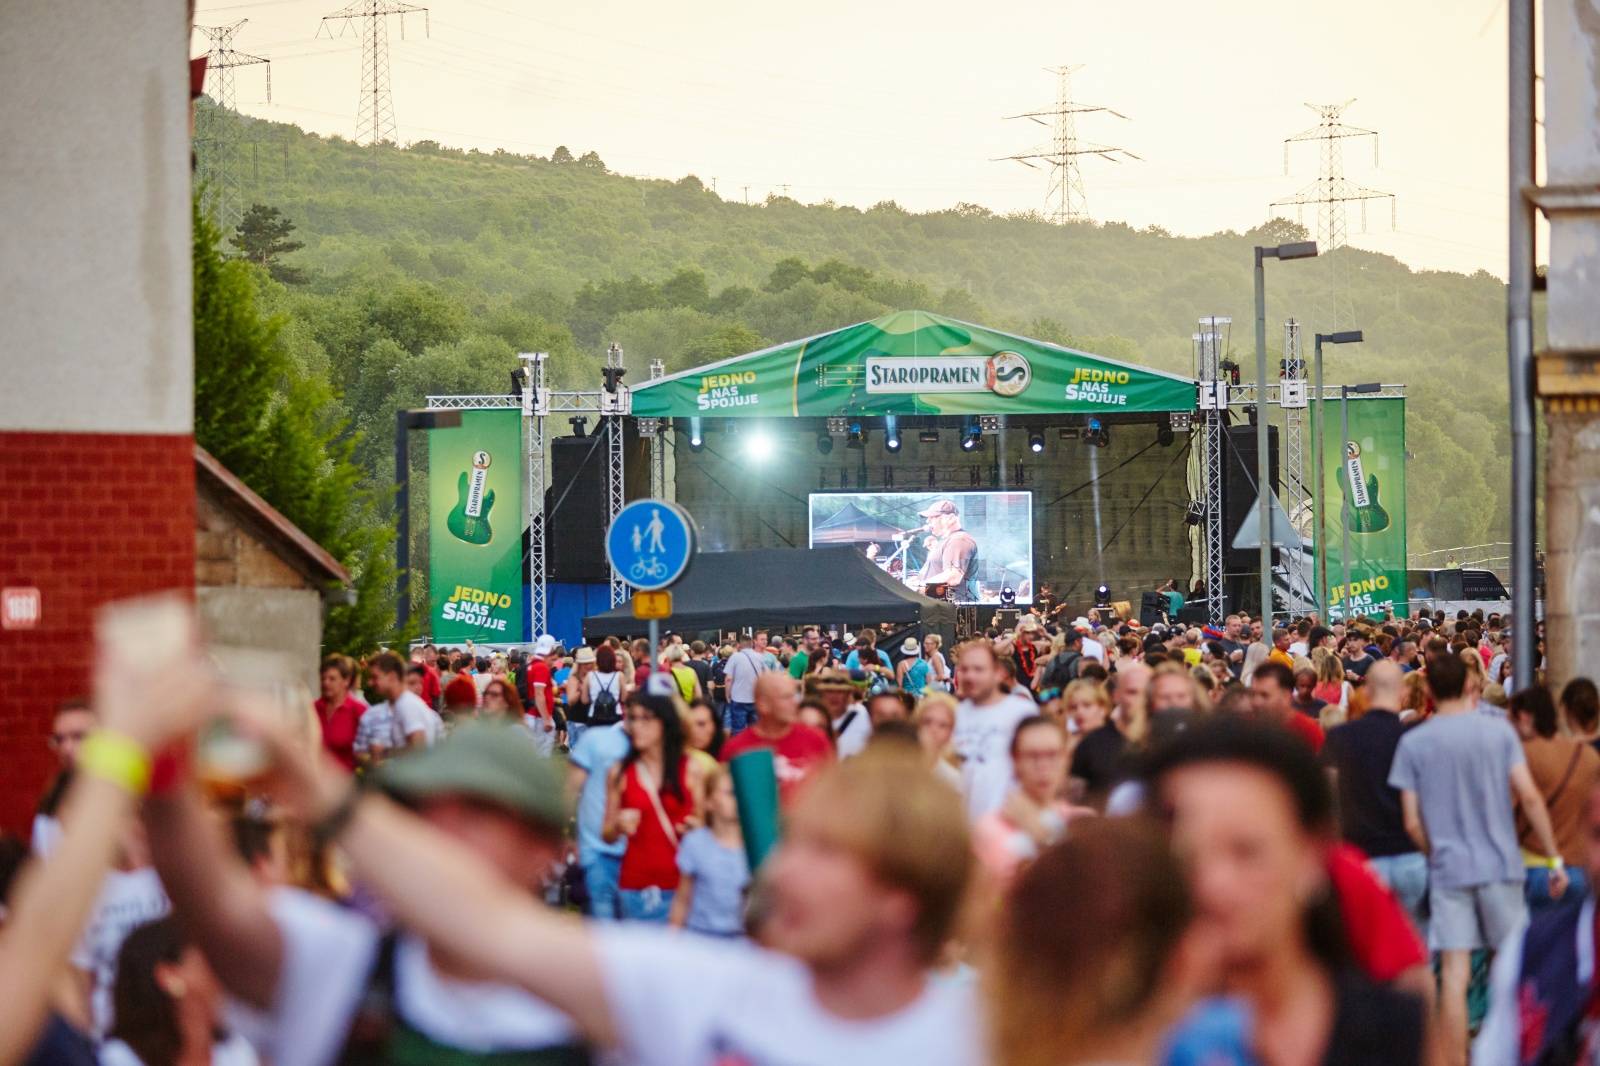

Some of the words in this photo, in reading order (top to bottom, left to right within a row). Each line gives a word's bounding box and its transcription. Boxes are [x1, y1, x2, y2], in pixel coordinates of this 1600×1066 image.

[699, 371, 756, 393] JEDNO
[871, 365, 980, 386] STAROPRAMEN
[1070, 368, 1130, 384] JEDNO
[697, 394, 759, 410] SPOJUJE
[1065, 384, 1127, 405] SPOJUJE
[448, 585, 512, 608] JEDNO
[442, 602, 507, 631] SPOJUJE
